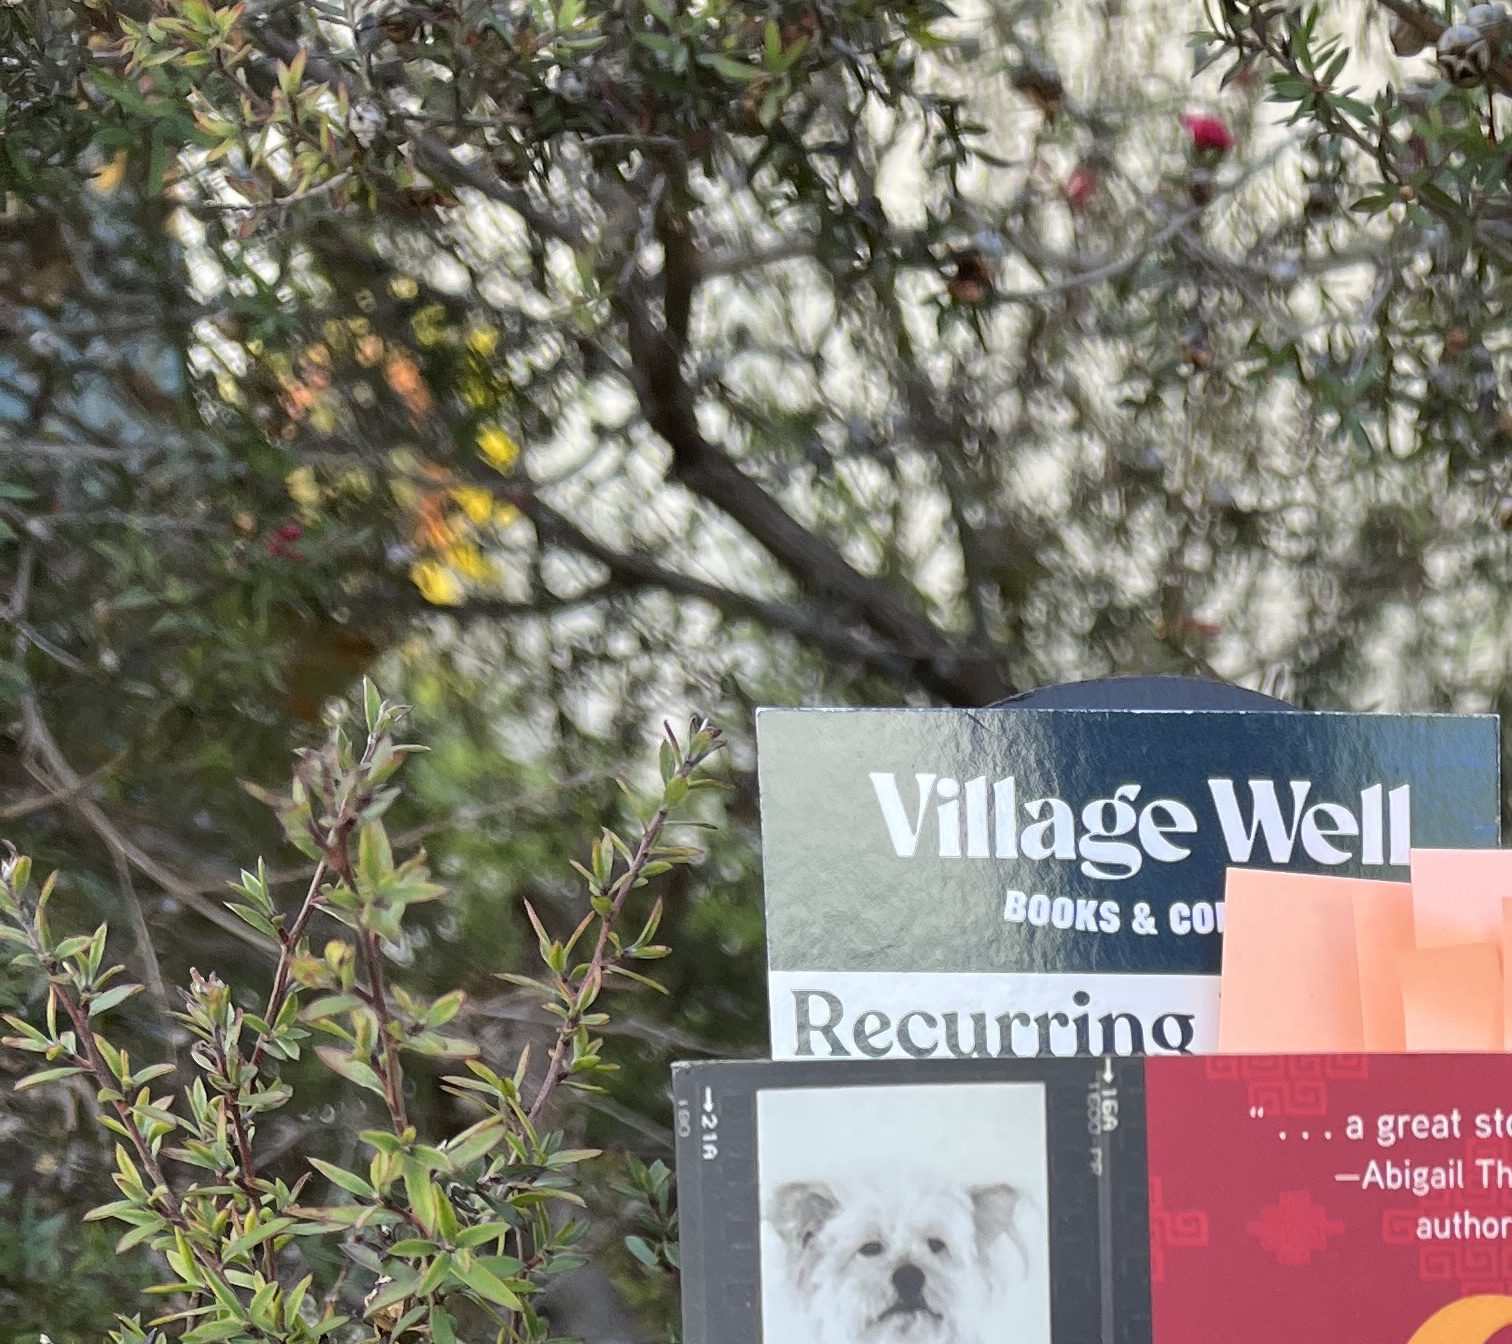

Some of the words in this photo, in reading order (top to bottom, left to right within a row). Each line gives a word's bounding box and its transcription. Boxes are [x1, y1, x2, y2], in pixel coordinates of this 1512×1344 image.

[869, 772, 1198, 880] Village
[1207, 778, 1412, 867] Well
[1004, 890, 1121, 934] BOOKS
[1131, 902, 1158, 935] &
[790, 989, 1196, 1057] Recurring
[700, 1113, 719, 1160] 21A
[1345, 1114, 1364, 1140] a
[1376, 1108, 1462, 1148] great
[1416, 1209, 1512, 1240] author
